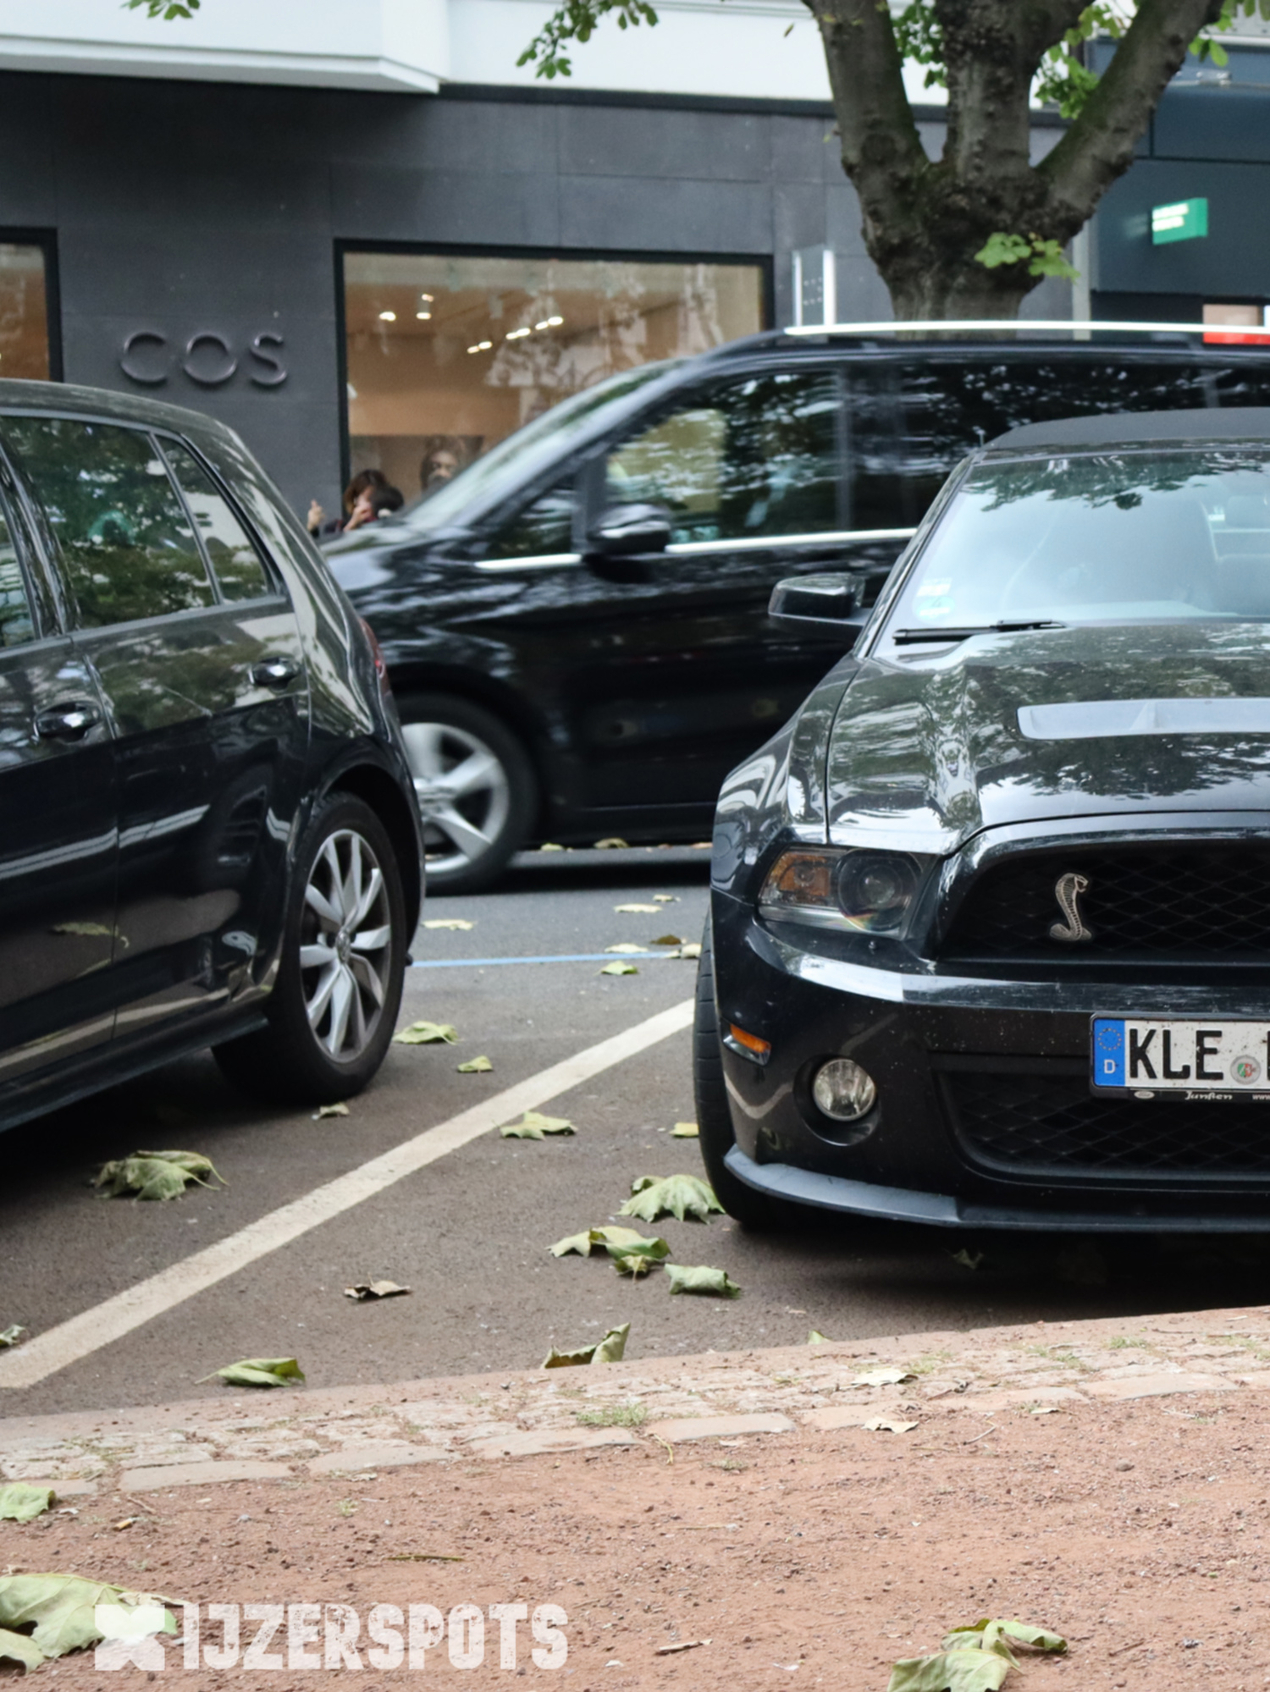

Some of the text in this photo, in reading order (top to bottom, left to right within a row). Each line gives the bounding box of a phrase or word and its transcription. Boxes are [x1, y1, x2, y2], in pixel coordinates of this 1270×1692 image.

[120, 330, 288, 386] COS
[1104, 1059, 1116, 1074] D
[1129, 1028, 1224, 1080] KLE
